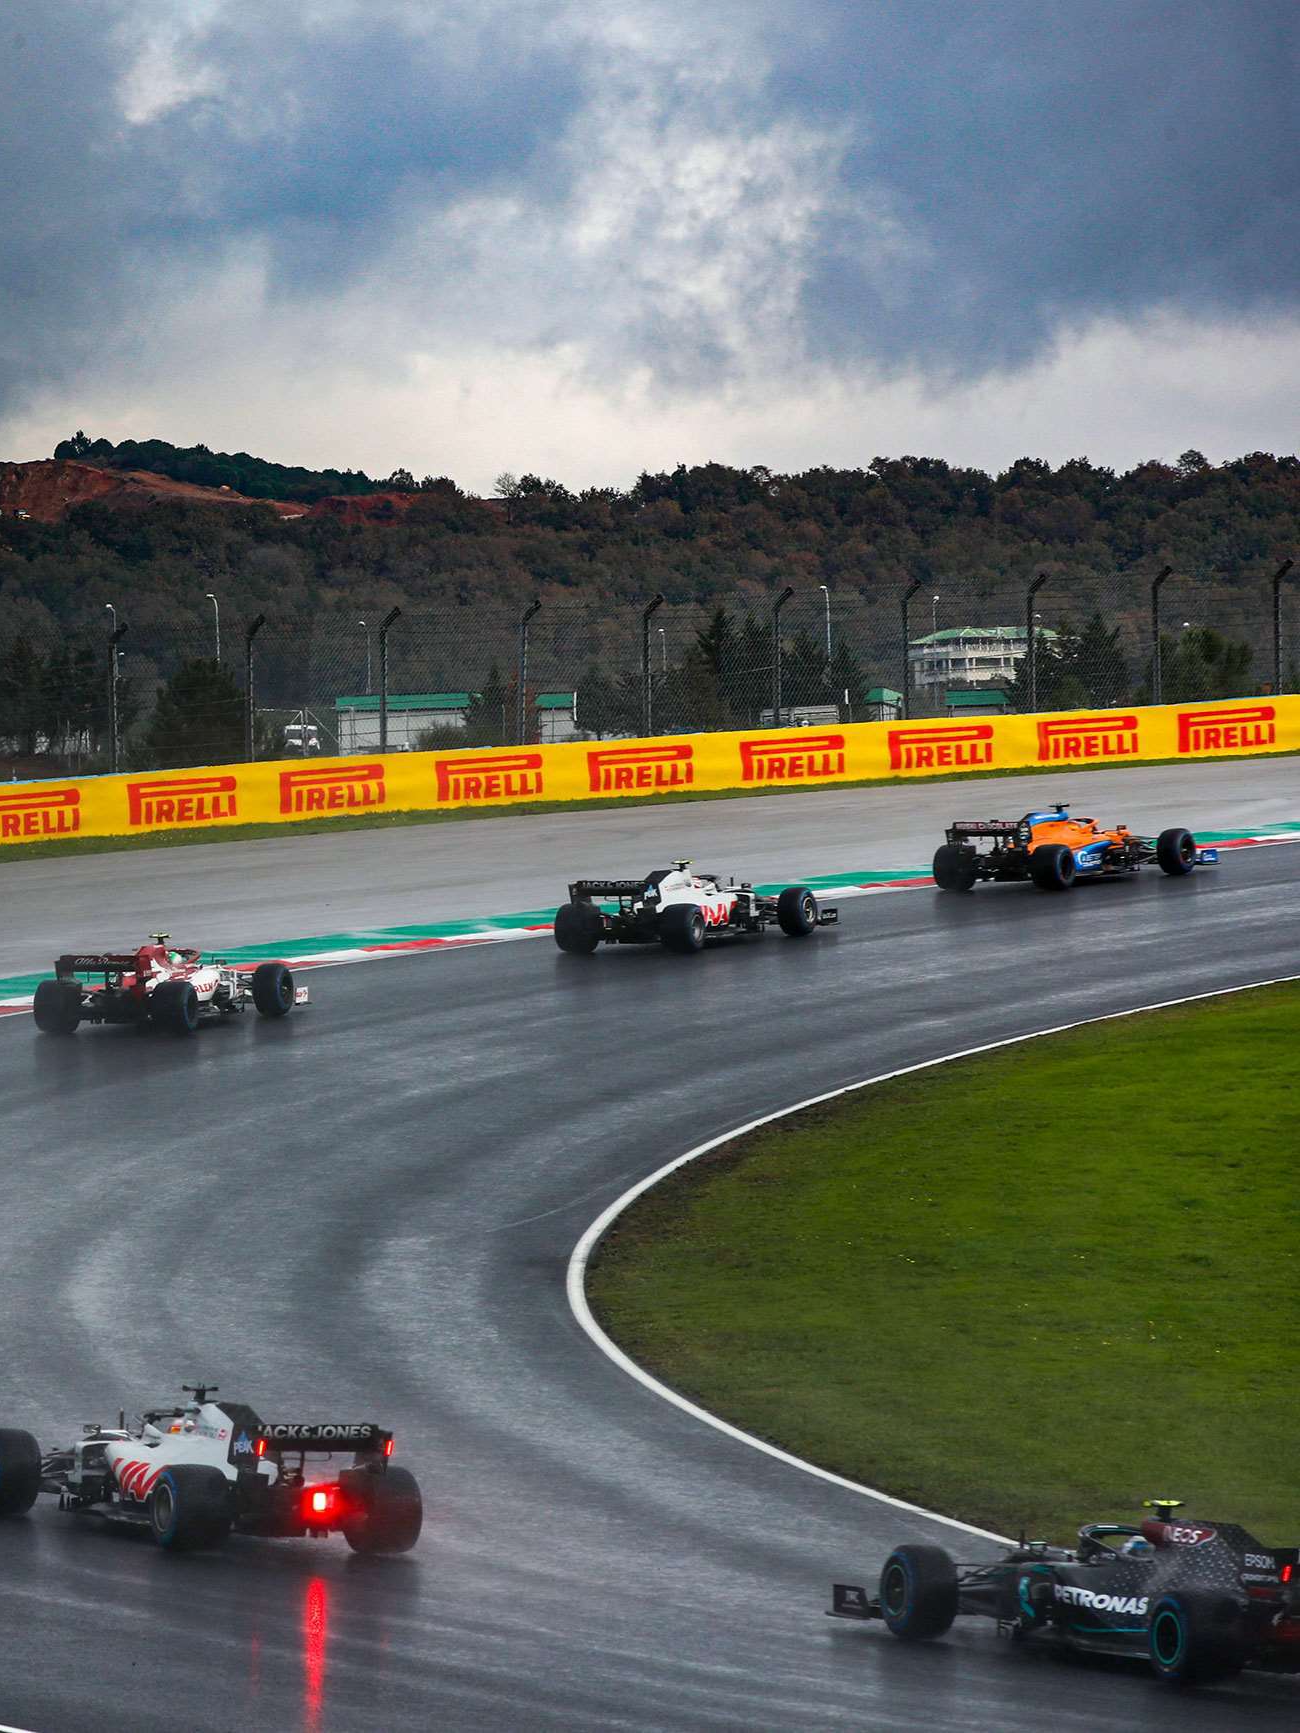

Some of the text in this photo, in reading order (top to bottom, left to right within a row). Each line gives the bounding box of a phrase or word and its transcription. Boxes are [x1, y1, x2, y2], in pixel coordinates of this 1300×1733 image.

[888, 725, 993, 770] PIRELLI
[1037, 716, 1138, 760] PIRELLI
[1177, 706, 1275, 753] PIRELLI
[435, 754, 543, 801] PIRELLI
[587, 745, 693, 792] PIRELLI
[740, 735, 844, 781] PIRELLI
[127, 776, 236, 825] PIRELLI
[280, 764, 385, 814] PIRELLI
[1164, 1525, 1203, 1544] INEOS
[1244, 1553, 1276, 1569] EPSON
[1054, 1584, 1149, 1615] PETRONAS
